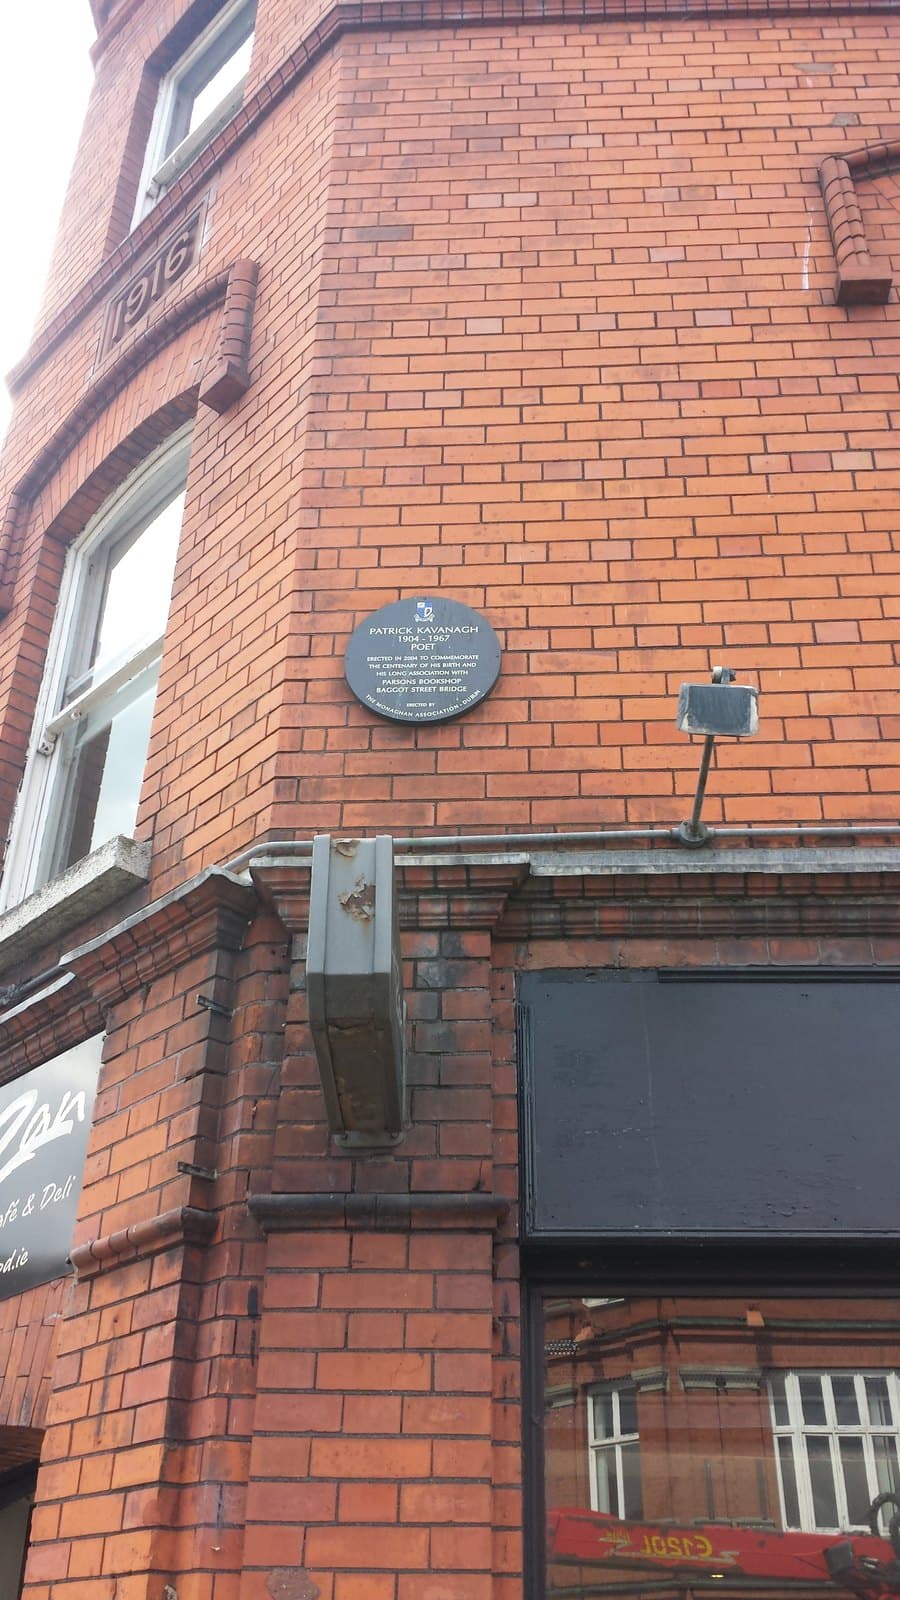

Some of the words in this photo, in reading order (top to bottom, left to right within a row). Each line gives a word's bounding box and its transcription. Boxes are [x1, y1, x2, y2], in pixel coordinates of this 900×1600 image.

[112, 231, 190, 341] 1916
[369, 627, 413, 635] PATRICK
[417, 626, 479, 634] KAVANAGH
[366, 694, 377, 705] THE
[376, 702, 414, 717] MONAGHAN
[415, 704, 460, 718] ASSOCIATION
[462, 689, 481, 706] DUBLIN
[22, 1193, 35, 1217] &
[40, 1175, 76, 1210] Deli
